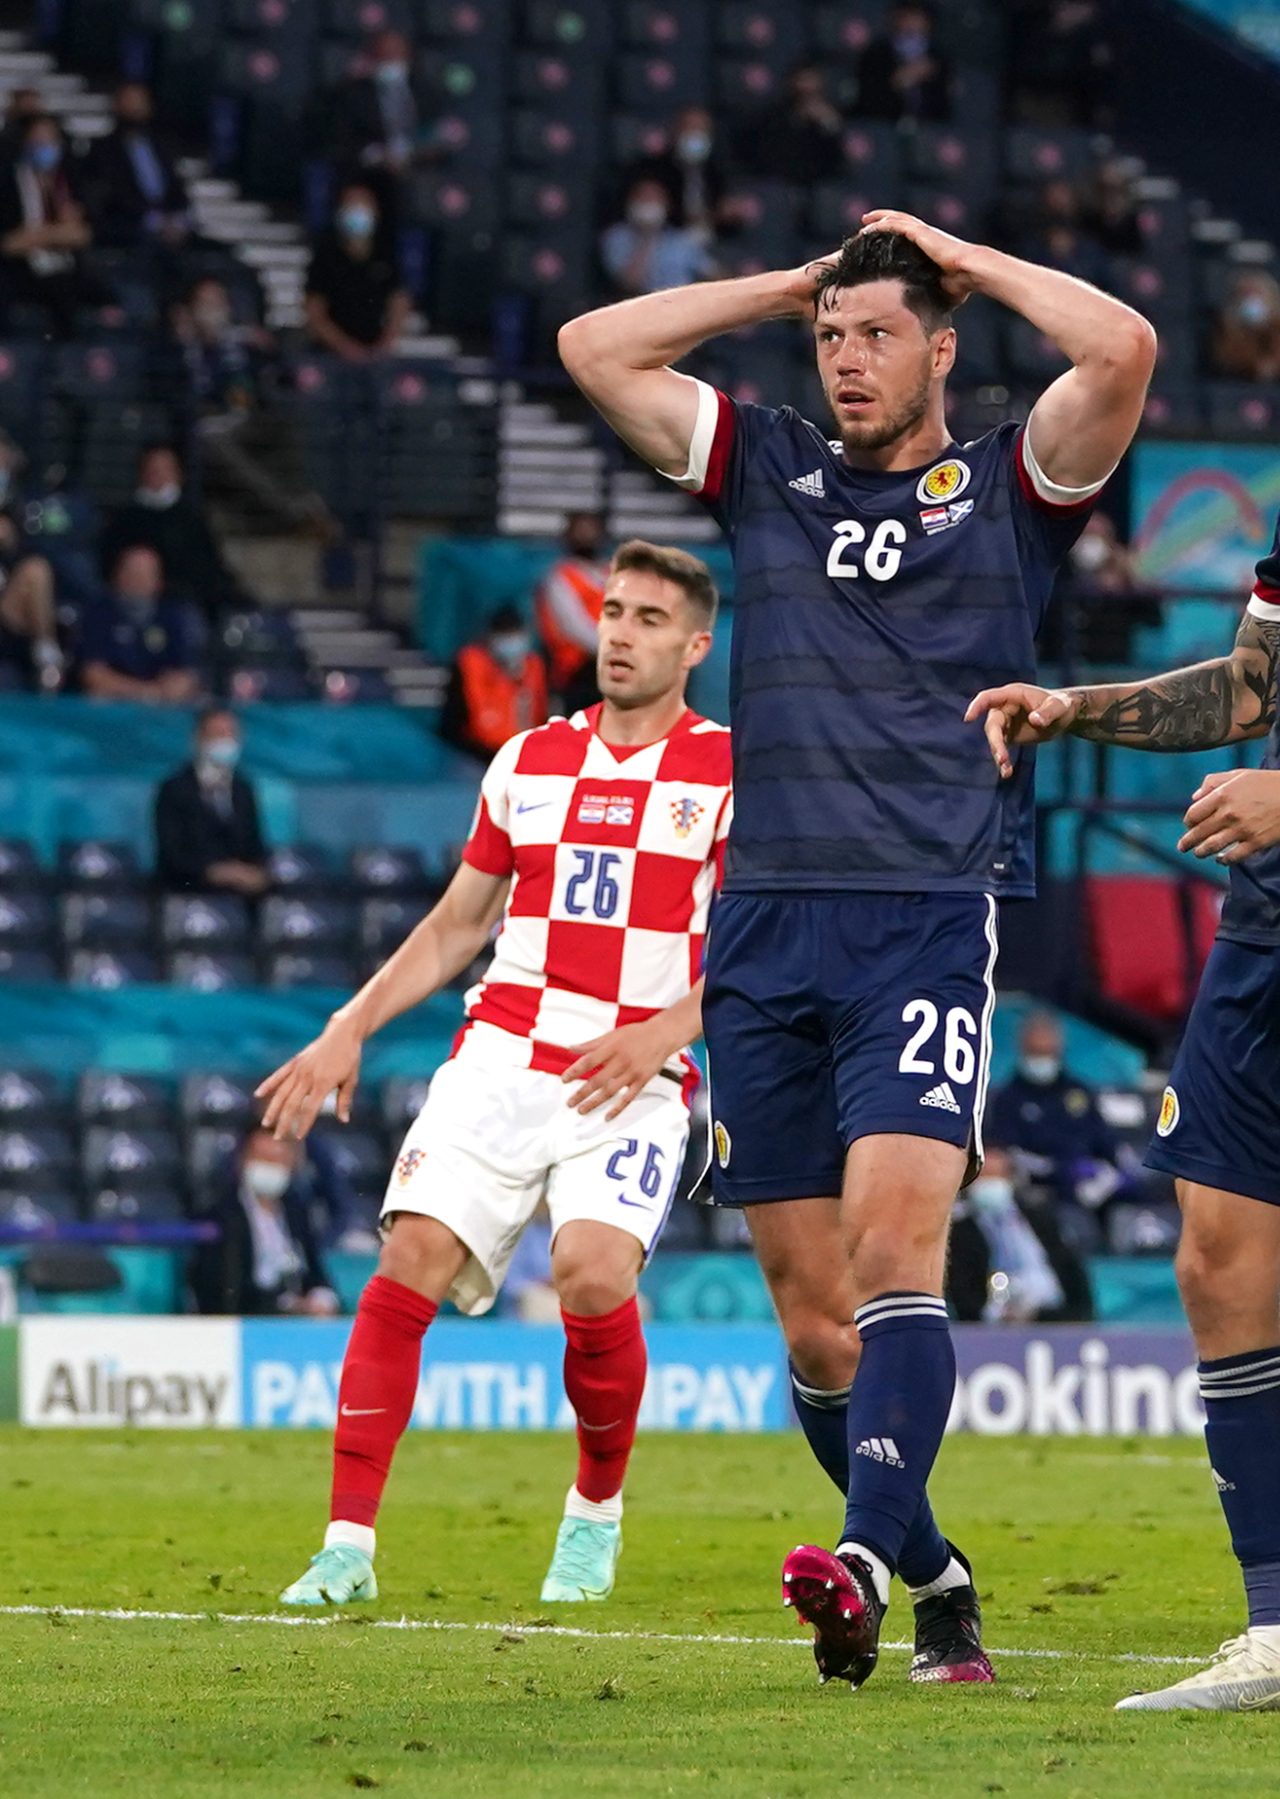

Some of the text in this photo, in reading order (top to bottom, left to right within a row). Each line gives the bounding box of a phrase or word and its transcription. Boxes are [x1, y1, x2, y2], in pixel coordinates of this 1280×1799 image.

[788, 480, 826, 499] adidas
[826, 518, 907, 582] 26
[564, 848, 622, 919] 26
[898, 998, 978, 1085] 26
[919, 1096, 961, 1114] adidas
[605, 1136, 666, 1198] 26
[42, 1354, 229, 1420] Alipay
[253, 1361, 345, 1428] PA
[855, 1446, 906, 1469] adidas
